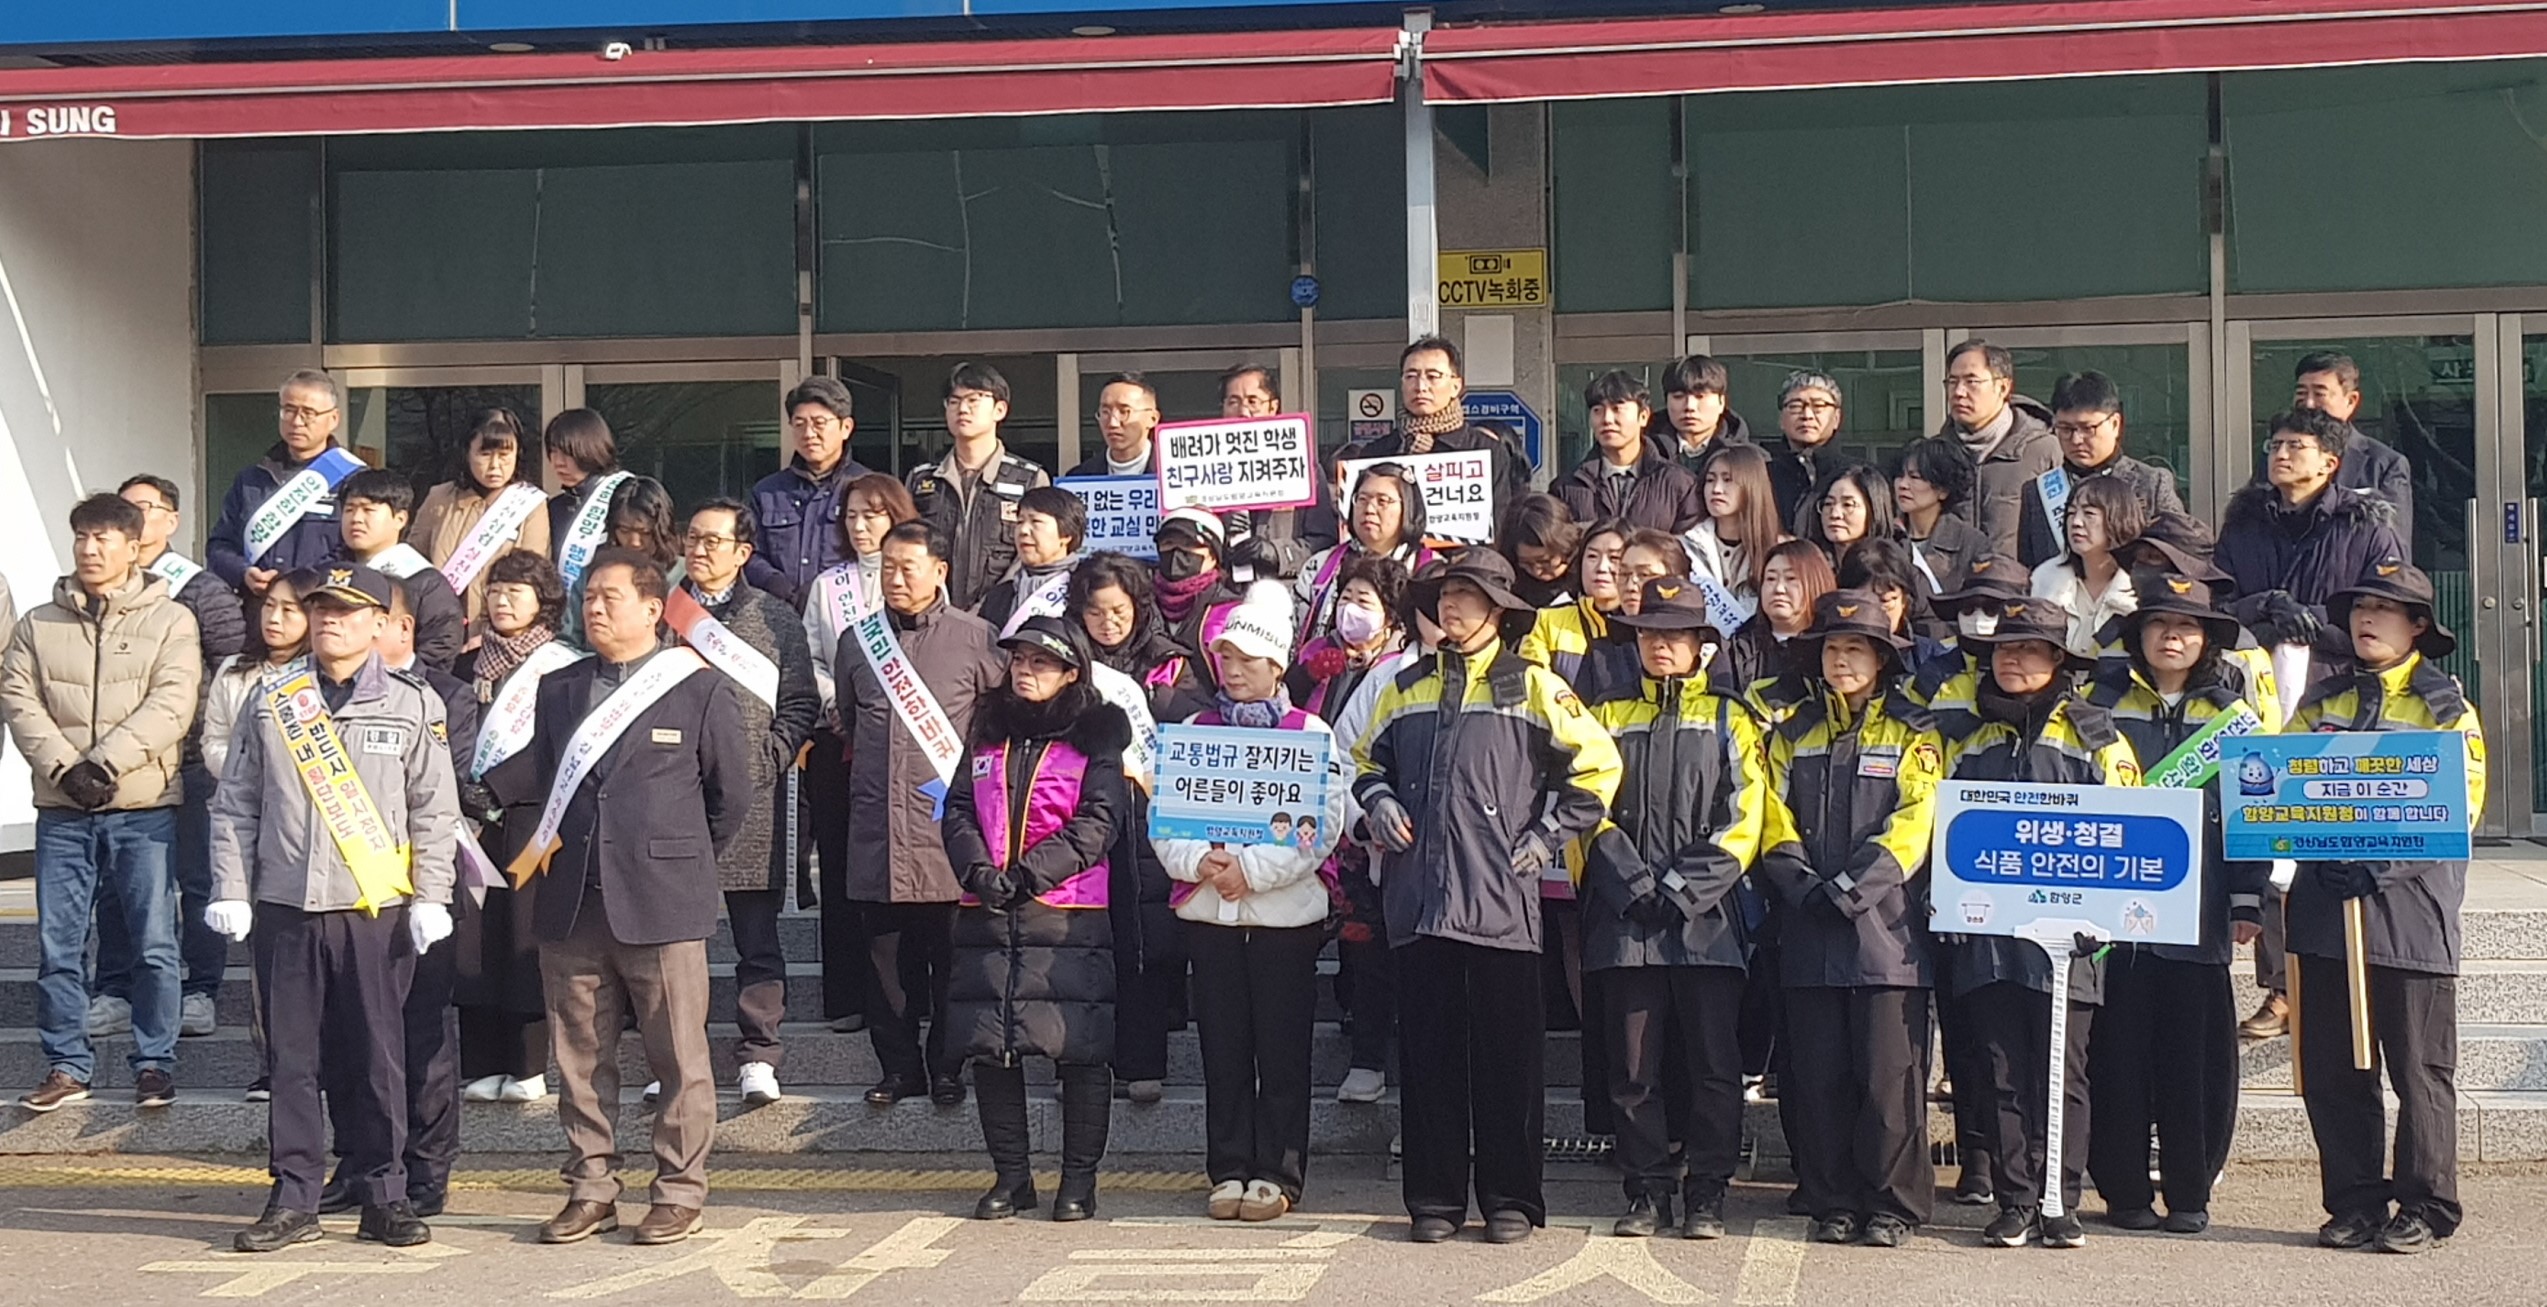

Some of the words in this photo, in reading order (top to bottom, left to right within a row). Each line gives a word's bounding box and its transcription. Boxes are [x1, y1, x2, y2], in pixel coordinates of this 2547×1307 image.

[26, 105, 116, 134] SUNG
[1438, 277, 1540, 303] CCTV녹화중
[1170, 432, 1220, 458] 배려가
[1225, 430, 1259, 455] 멋진
[1263, 427, 1297, 451] 학생
[1166, 461, 1233, 489] 친구사랑
[1238, 456, 1305, 482] 지켜주자
[1424, 460, 1484, 483] 살피고
[1094, 490, 1124, 511] 없는
[1128, 489, 1158, 510] 우리
[1425, 484, 1485, 506] 건너요
[1110, 516, 1140, 537] 교실
[880, 656, 955, 760] 안전한바퀴
[296, 742, 315, 764] 내
[1169, 741, 1239, 768] 교통법규
[1244, 744, 1314, 773] 잘지키는
[2287, 757, 2350, 775] 청렴하고
[2354, 756, 2403, 774] 깨끗한
[2406, 755, 2439, 773] 세상
[309, 722, 348, 777] 반드시
[339, 780, 387, 852] 일시정지
[1175, 776, 1244, 804] 어른들이
[1250, 780, 1302, 806] 좋아요
[1960, 789, 2012, 804] 대한민국
[2014, 791, 2080, 807] 안전한바퀴
[2321, 782, 2352, 797] 지금
[2356, 783, 2371, 797] 이
[2376, 782, 2409, 797] 순간
[2373, 806, 2401, 822] 함께
[2404, 806, 2449, 823] 합니다
[2014, 819, 2124, 848] 위생·청결
[1974, 850, 2024, 876] 식품
[2030, 852, 2105, 880] 안전의
[2113, 856, 2164, 882] 기본
[2049, 892, 2083, 906] 함양군
